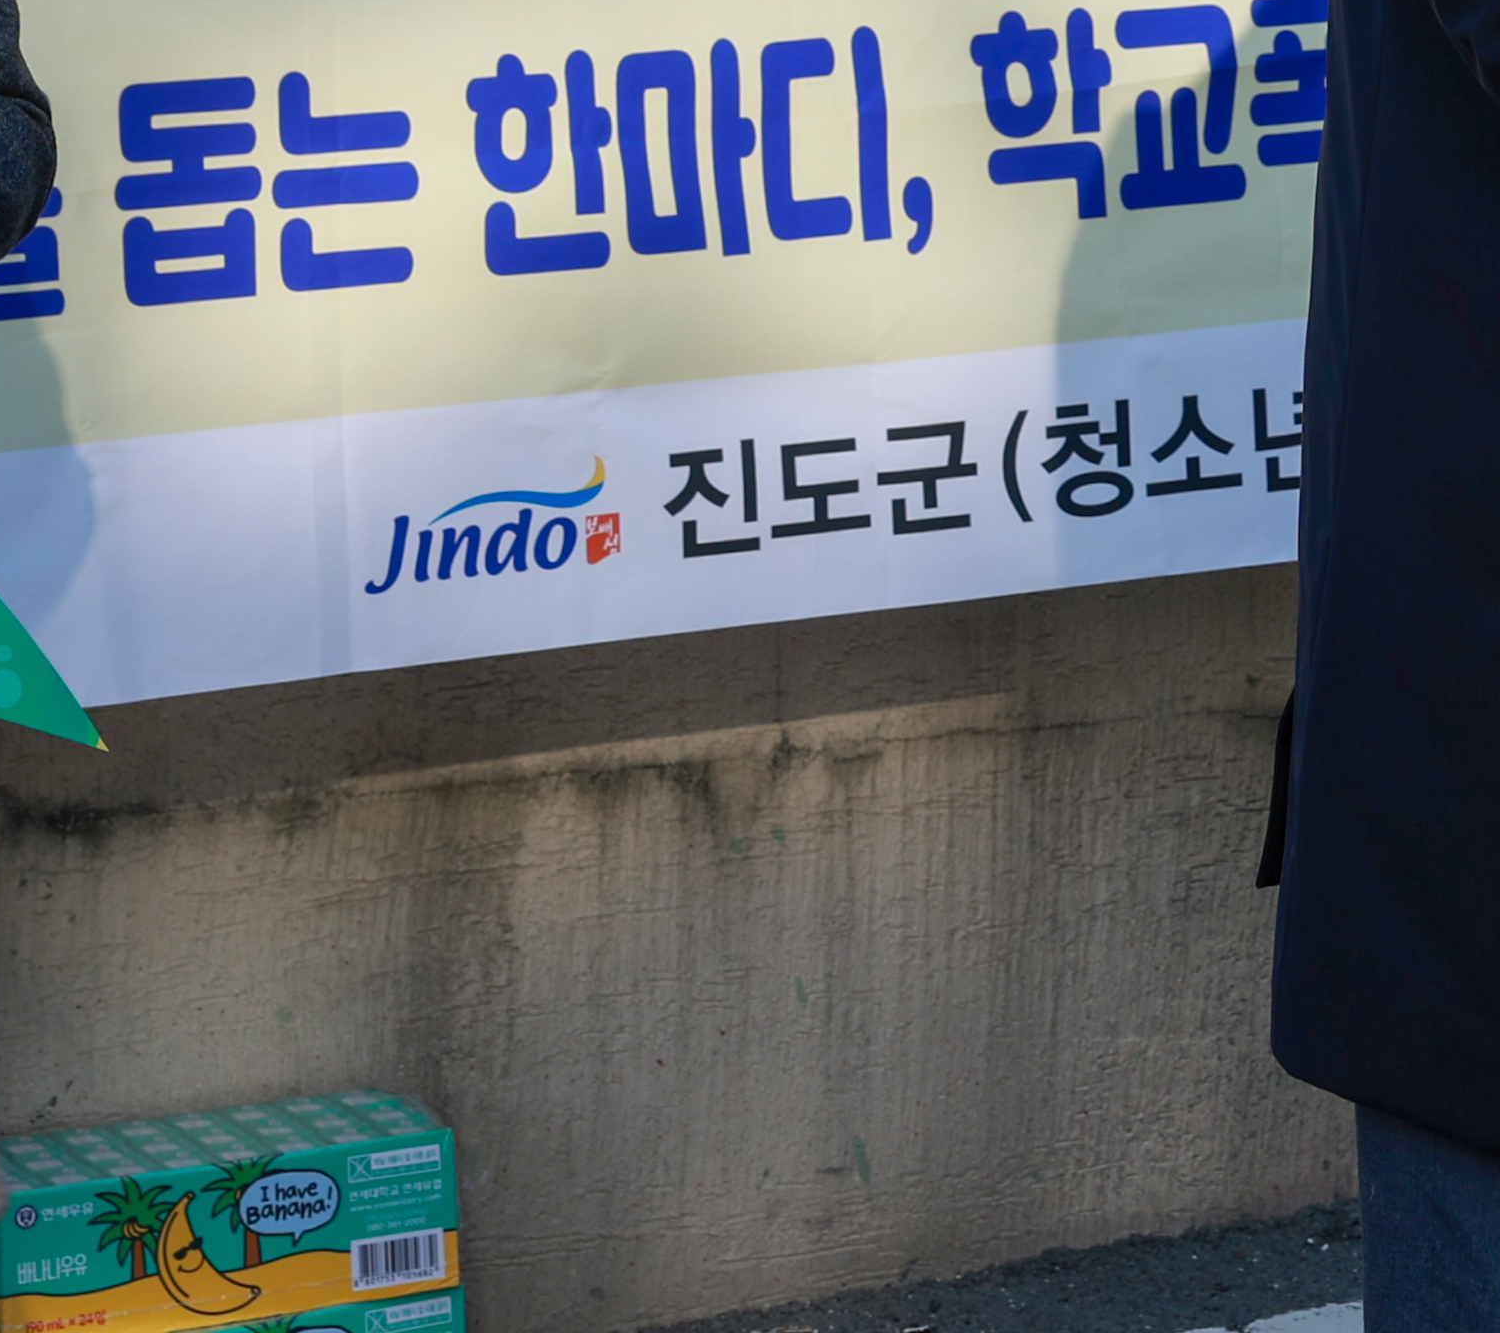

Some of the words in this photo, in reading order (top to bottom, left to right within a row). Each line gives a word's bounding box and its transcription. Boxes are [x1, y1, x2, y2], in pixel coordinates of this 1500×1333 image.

[115, 70, 420, 307] 돕는
[466, 25, 934, 279] 한마디,
[364, 504, 579, 596] Jindo
[245, 1186, 334, 1225] Banana!
[260, 1186, 270, 1203] I
[274, 1181, 318, 1204] have
[37, 1201, 94, 1223] 연세우유
[15, 1252, 88, 1285] 바나나우유
